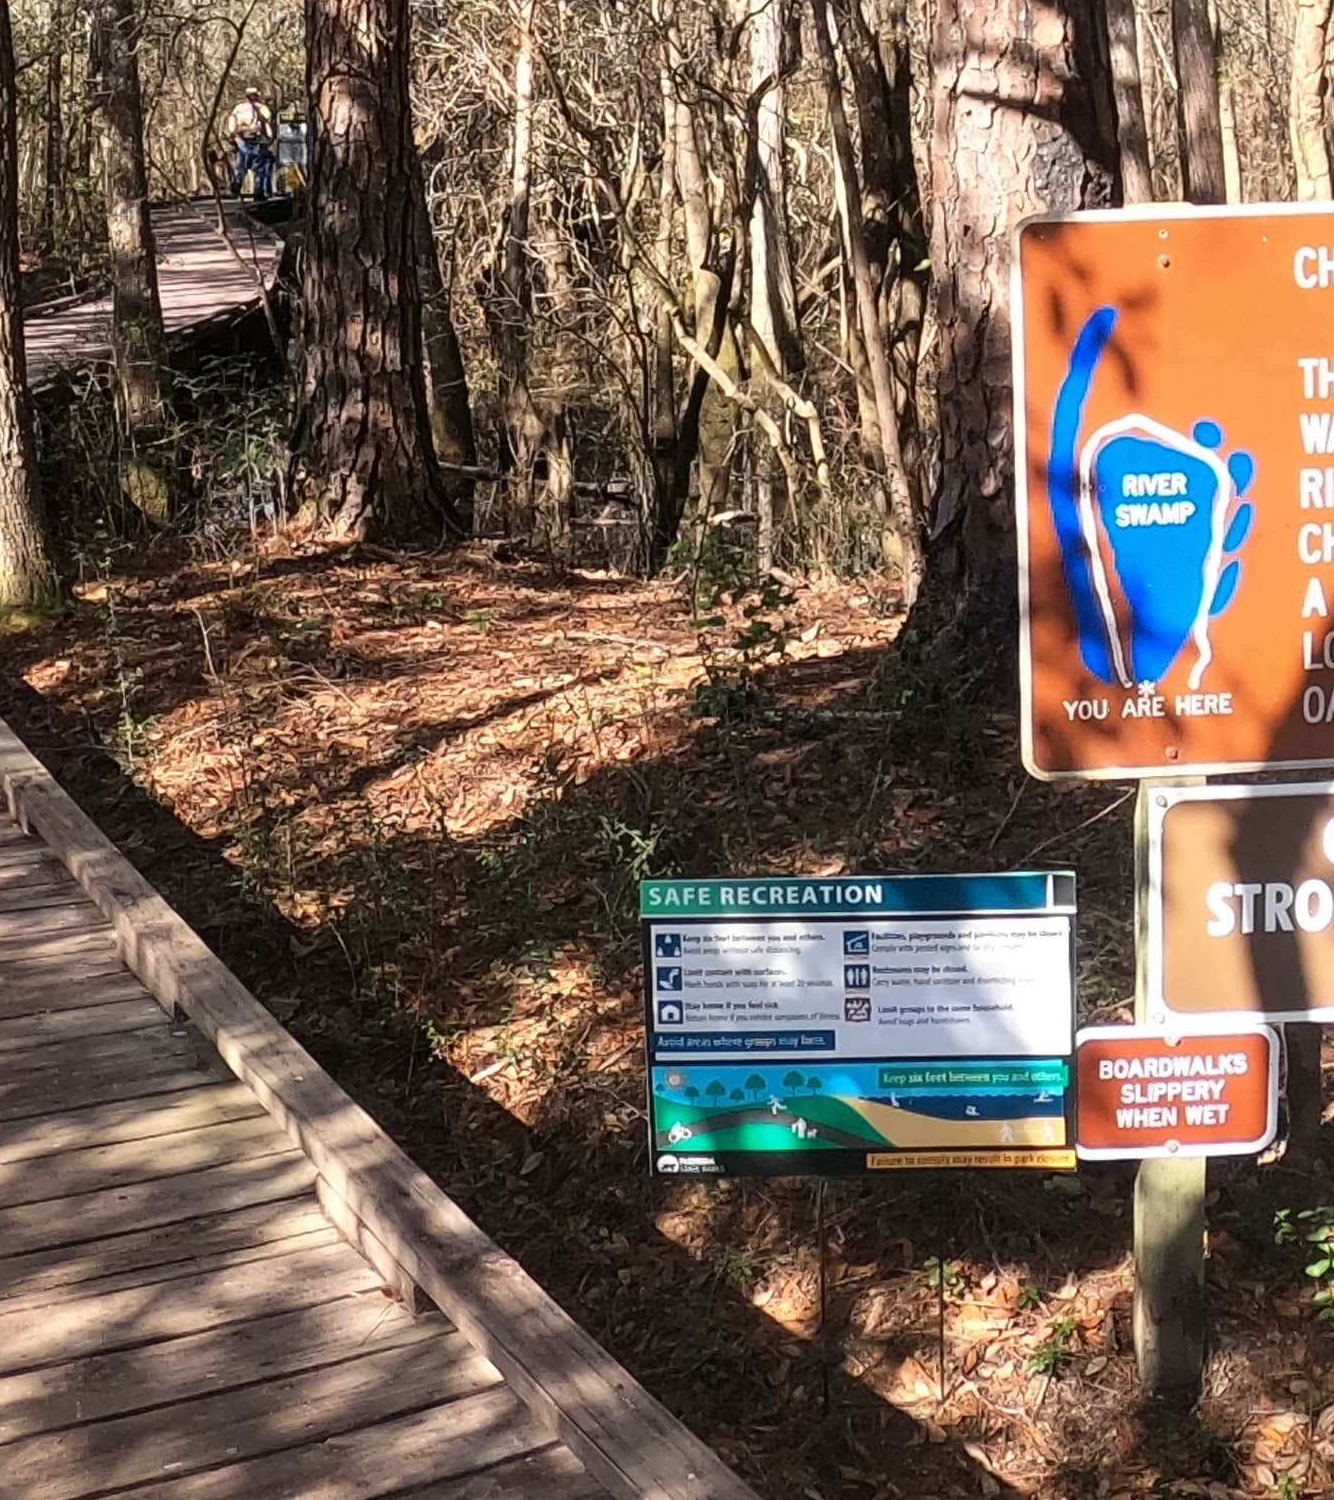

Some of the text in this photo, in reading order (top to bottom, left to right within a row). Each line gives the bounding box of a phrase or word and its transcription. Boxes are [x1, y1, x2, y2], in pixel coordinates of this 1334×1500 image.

[1121, 472, 1188, 498] RIVER
[1115, 500, 1196, 528] SWAMP
[1302, 578, 1328, 618] A
[1063, 693, 1233, 721] YOU ARE HERE
[649, 885, 883, 906] SAFE RECREATION
[883, 1073, 905, 1085] Keep
[908, 1072, 923, 1083] six
[925, 1071, 946, 1083] feet
[949, 1071, 989, 1083] between
[992, 1073, 1009, 1084] you
[1011, 1071, 1028, 1082] and
[1099, 1053, 1248, 1079] BOARDWALKS
[1120, 1080, 1225, 1104] SLIPPERY
[1116, 1104, 1230, 1129] WHEN WET
